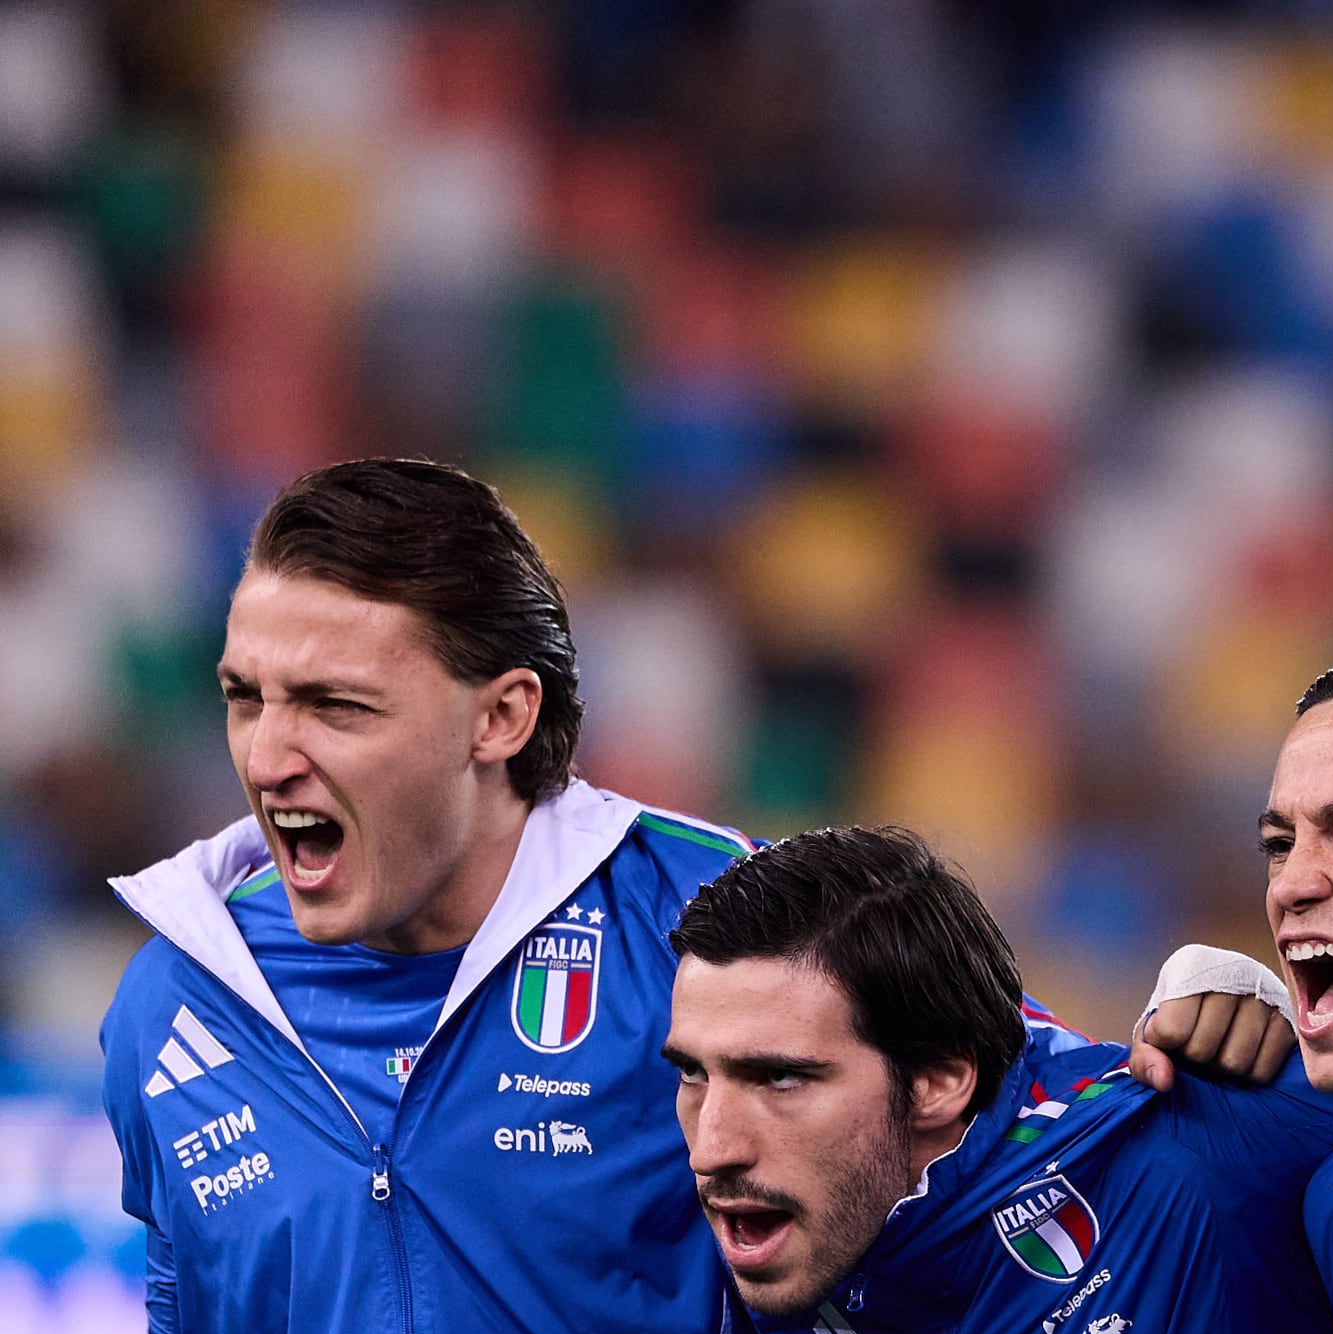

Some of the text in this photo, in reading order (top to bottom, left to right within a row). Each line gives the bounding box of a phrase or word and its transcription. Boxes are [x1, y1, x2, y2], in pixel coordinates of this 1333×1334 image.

[526, 937, 593, 961] ITALIA
[514, 1074, 591, 1097] Telepass
[202, 1104, 257, 1152] TIM
[494, 1121, 545, 1152] eni
[190, 1152, 271, 1209] Poste
[997, 1187, 1068, 1232] ITALIA
